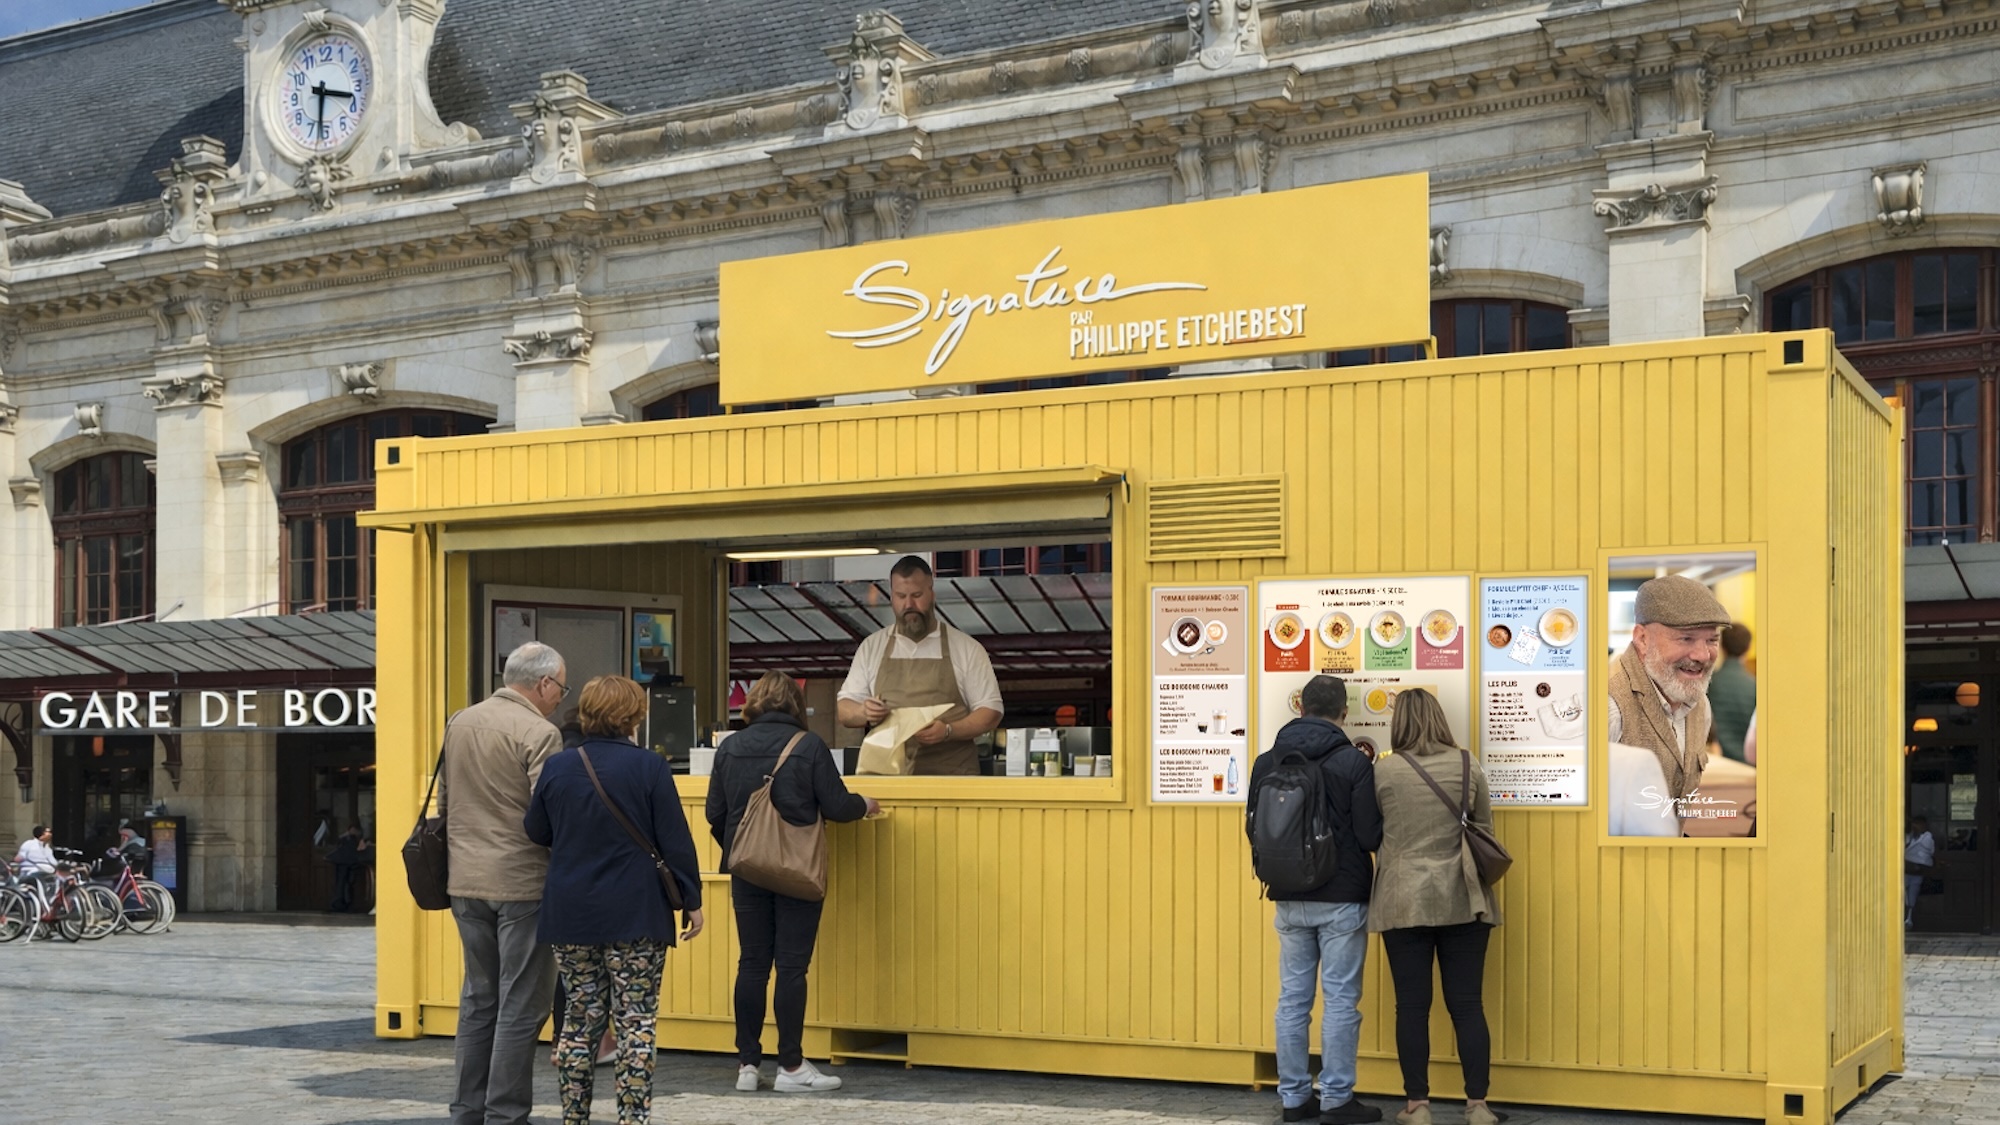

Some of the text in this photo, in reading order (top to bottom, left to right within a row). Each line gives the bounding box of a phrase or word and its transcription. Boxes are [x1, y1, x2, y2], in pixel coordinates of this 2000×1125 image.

[319, 45, 333, 62] 12
[338, 47, 344, 63] 1
[350, 57, 359, 74] 2
[353, 79, 362, 92] 3
[291, 93, 298, 106] 9
[295, 112, 303, 126] 8
[307, 122, 316, 138] 7
[826, 245, 1208, 376] Signature
[1070, 311, 1093, 326] PAR
[1070, 304, 1307, 358] PHILIPPE ETCHEBEST
[39, 688, 377, 728] GARE DE BOR
[1159, 748, 1170, 756] LES
[1633, 786, 1737, 818] Signature
